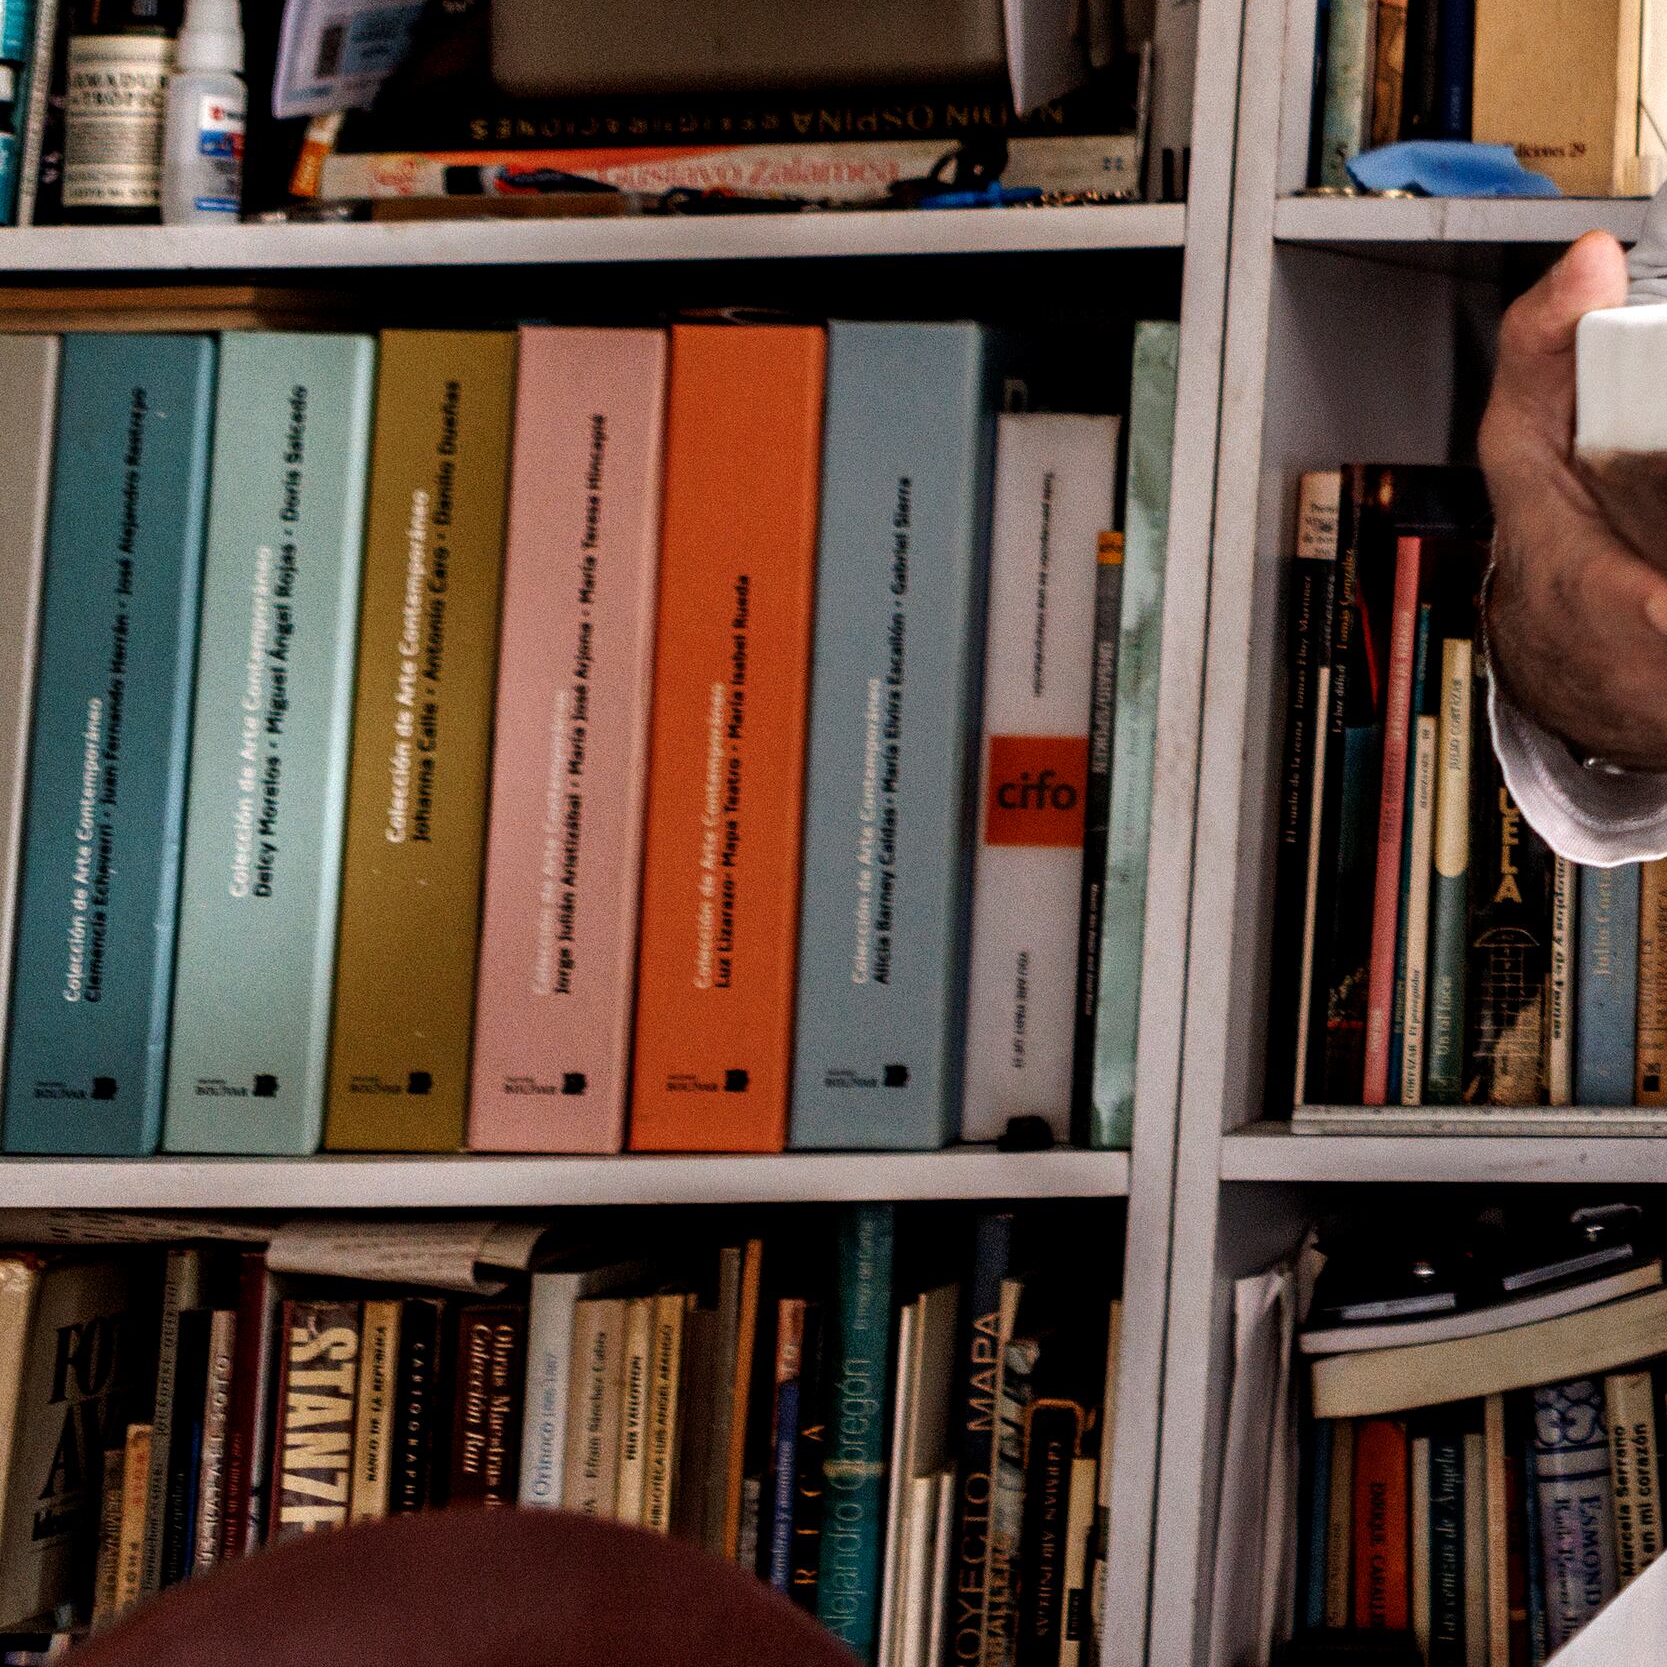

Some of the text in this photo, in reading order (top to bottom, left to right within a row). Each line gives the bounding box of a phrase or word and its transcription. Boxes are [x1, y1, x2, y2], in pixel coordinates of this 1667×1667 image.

[282, 386, 309, 465] Salcedo
[277, 470, 302, 522] Doris
[579, 494, 602, 550] Teresa
[892, 476, 914, 528] Sierra
[272, 544, 300, 600] Rojas
[575, 555, 597, 604] María
[888, 532, 910, 596] Gabriel
[410, 380, 461, 843] Johanna Calle Antonio Caro Danilo Dueñas
[731, 575, 751, 629] Rueda
[264, 605, 294, 662] Ángel
[727, 634, 748, 685] Isabel
[384, 489, 431, 844] Colección de Arte Contemporáneo
[228, 546, 274, 898] Colección de Arte Contemporáneo
[265, 667, 289, 735] Miguel
[568, 683, 590, 721] José
[725, 691, 747, 740] María
[883, 690, 904, 740] Elvira
[565, 726, 587, 776] María
[880, 743, 902, 793] María
[1288, 757, 1300, 769] la
[257, 756, 282, 835] Morelos
[722, 758, 743, 814] Teatro
[996, 769, 1079, 811] cifo
[1287, 773, 1300, 787] de
[63, 698, 103, 1003] Colección de Arte Contemporáneo
[700, 831, 719, 871] Arte
[719, 820, 740, 867] Mapa
[856, 828, 876, 866] Arte
[877, 807, 900, 866] Caldas
[697, 875, 717, 898] de
[853, 869, 873, 892] de
[849, 896, 873, 985] Colección
[873, 935, 894, 985] Alicia
[1552, 936, 1566, 974] y de
[553, 946, 577, 996] Jorge
[714, 958, 734, 989] Luz
[491, 1325, 514, 1387] Obras
[965, 1311, 999, 1432] MAPA
[368, 1419, 380, 1435] DE
[370, 1398, 382, 1412] LA
[821, 1357, 880, 1645] Alejandro Obregón
[1612, 1425, 1635, 1576] Marcela Serrano
[1631, 1423, 1655, 1553] en mi corazón
[1429, 1446, 1464, 1642] Las cenizas de Ángela
